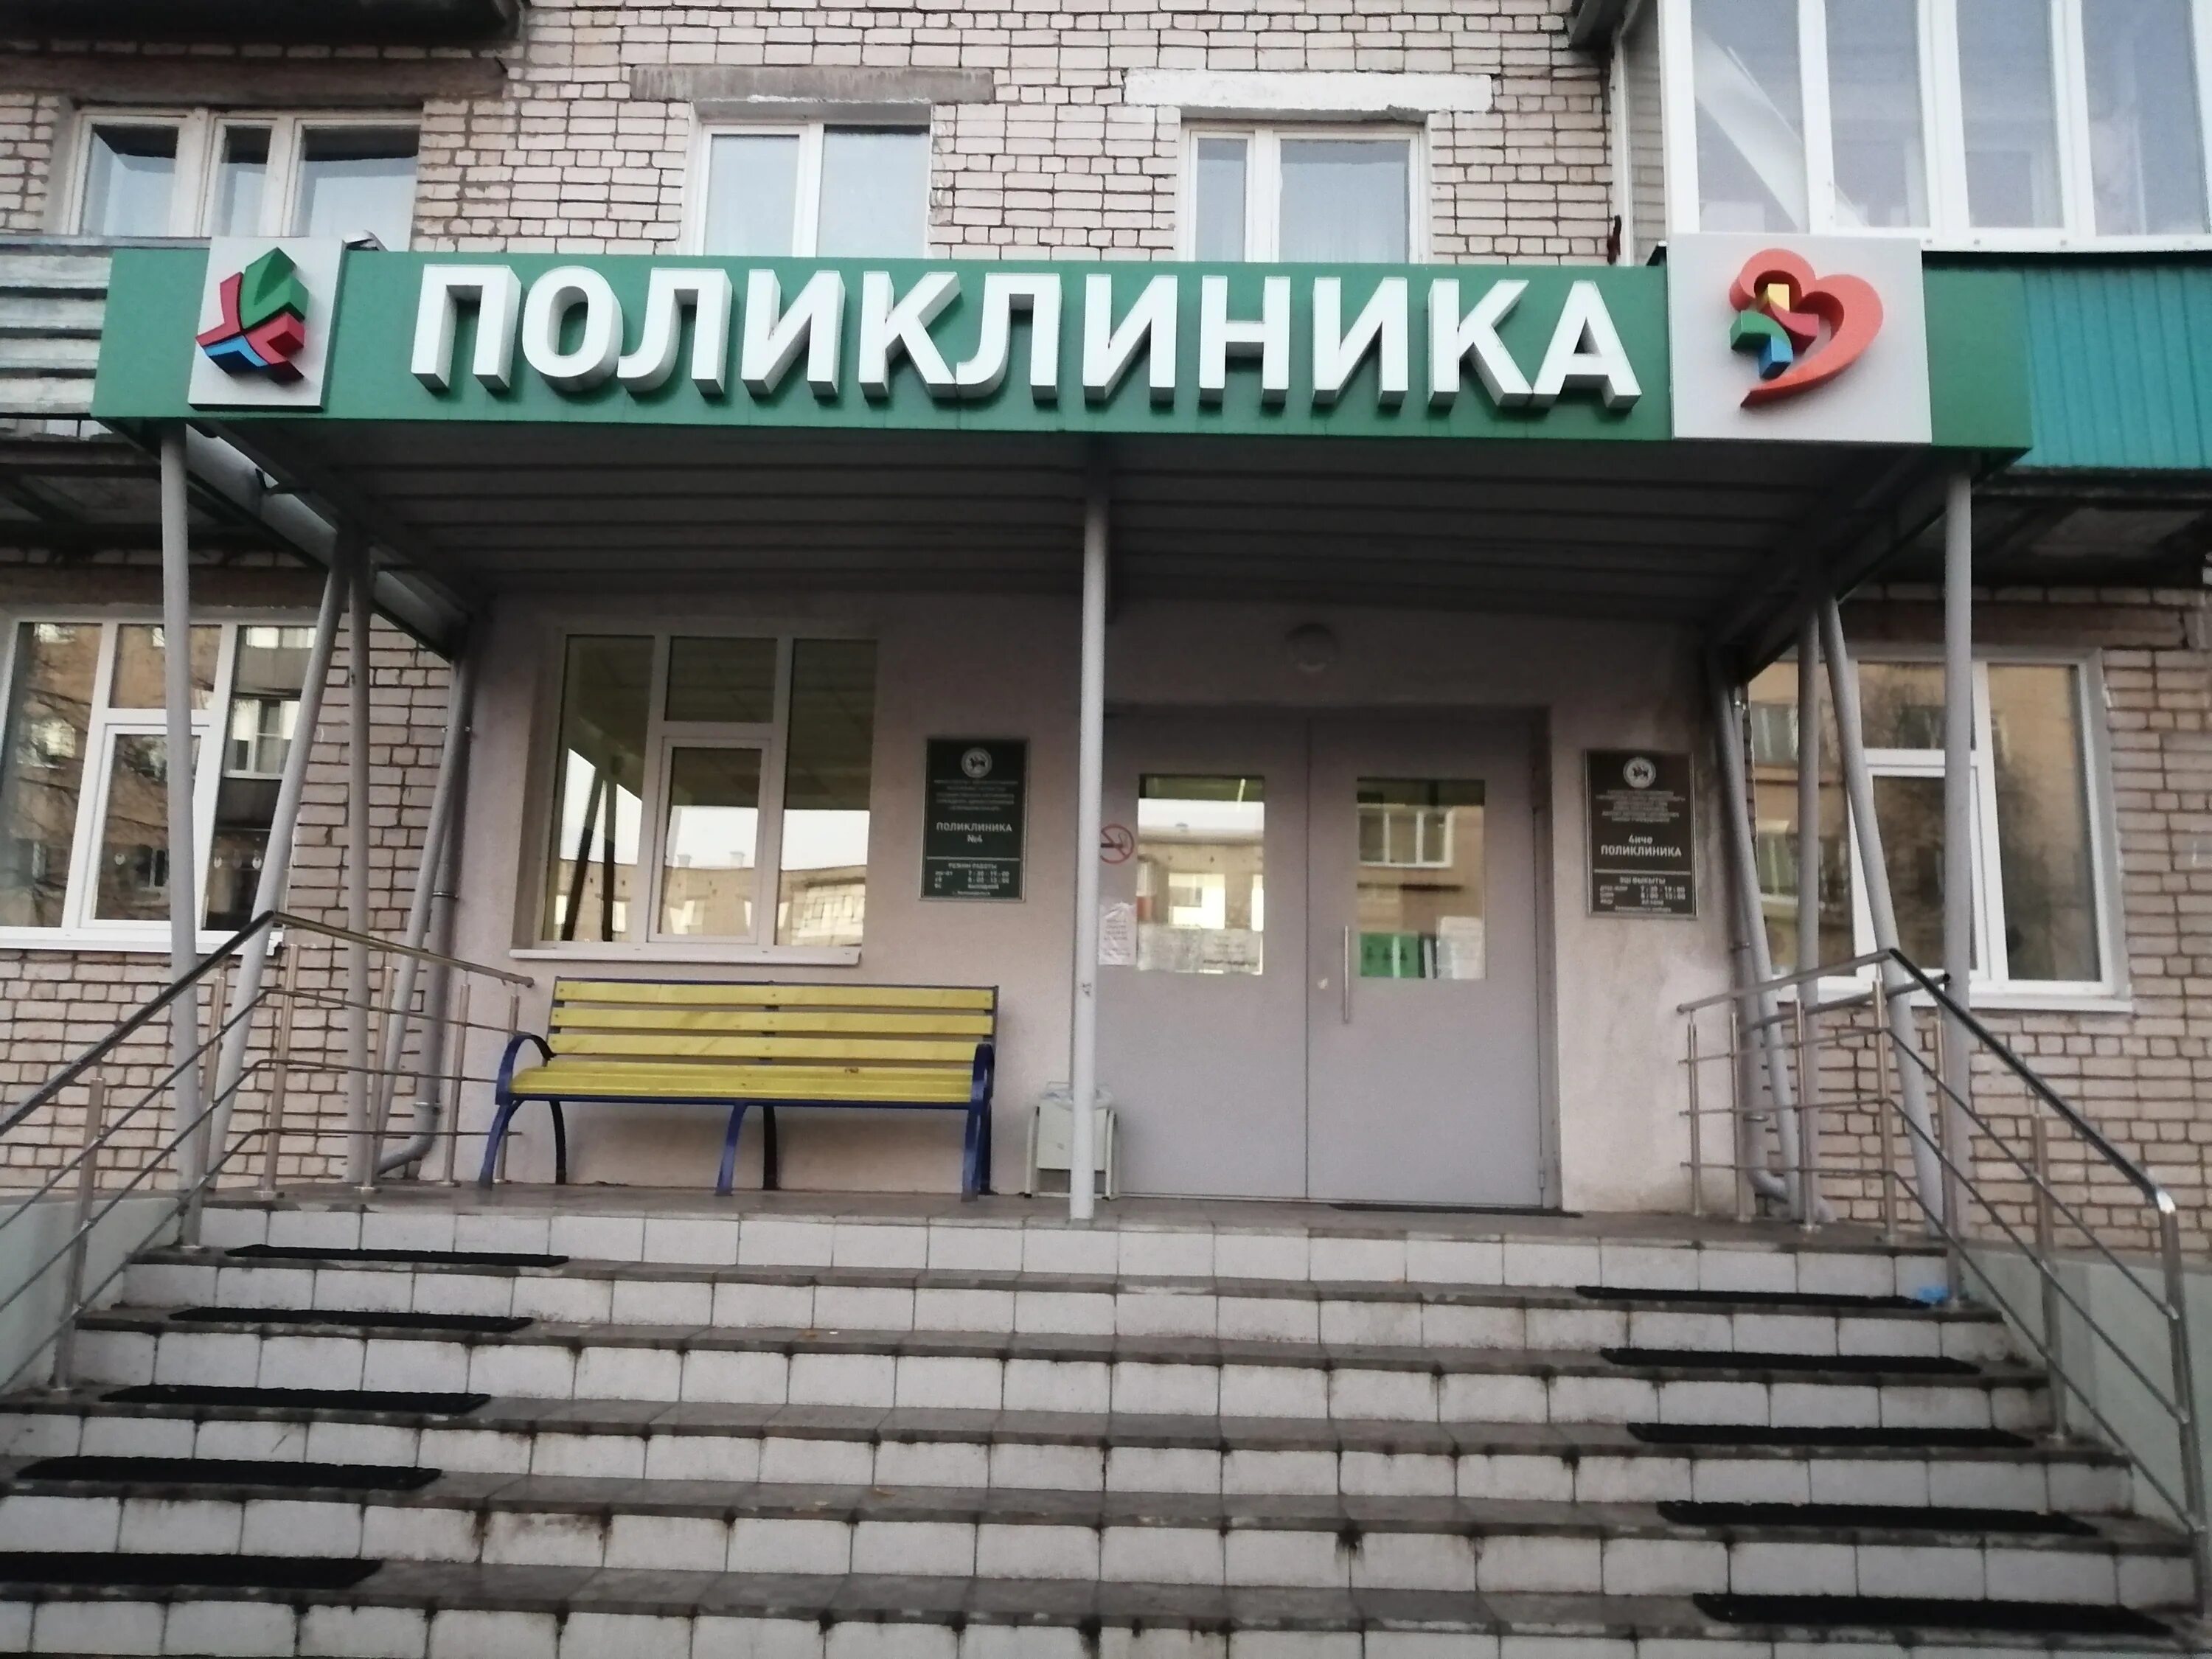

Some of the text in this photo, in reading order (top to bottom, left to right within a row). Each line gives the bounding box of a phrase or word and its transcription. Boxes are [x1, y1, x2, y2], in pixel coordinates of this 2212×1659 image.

[410, 263, 1642, 410] ПОЛИКЛИНИКА
[936, 821, 1012, 832] ПОЛИКЛИНИКА
[967, 834, 983, 844] №4
[1601, 844, 1682, 857] ПОЛИКЛИНИКА
